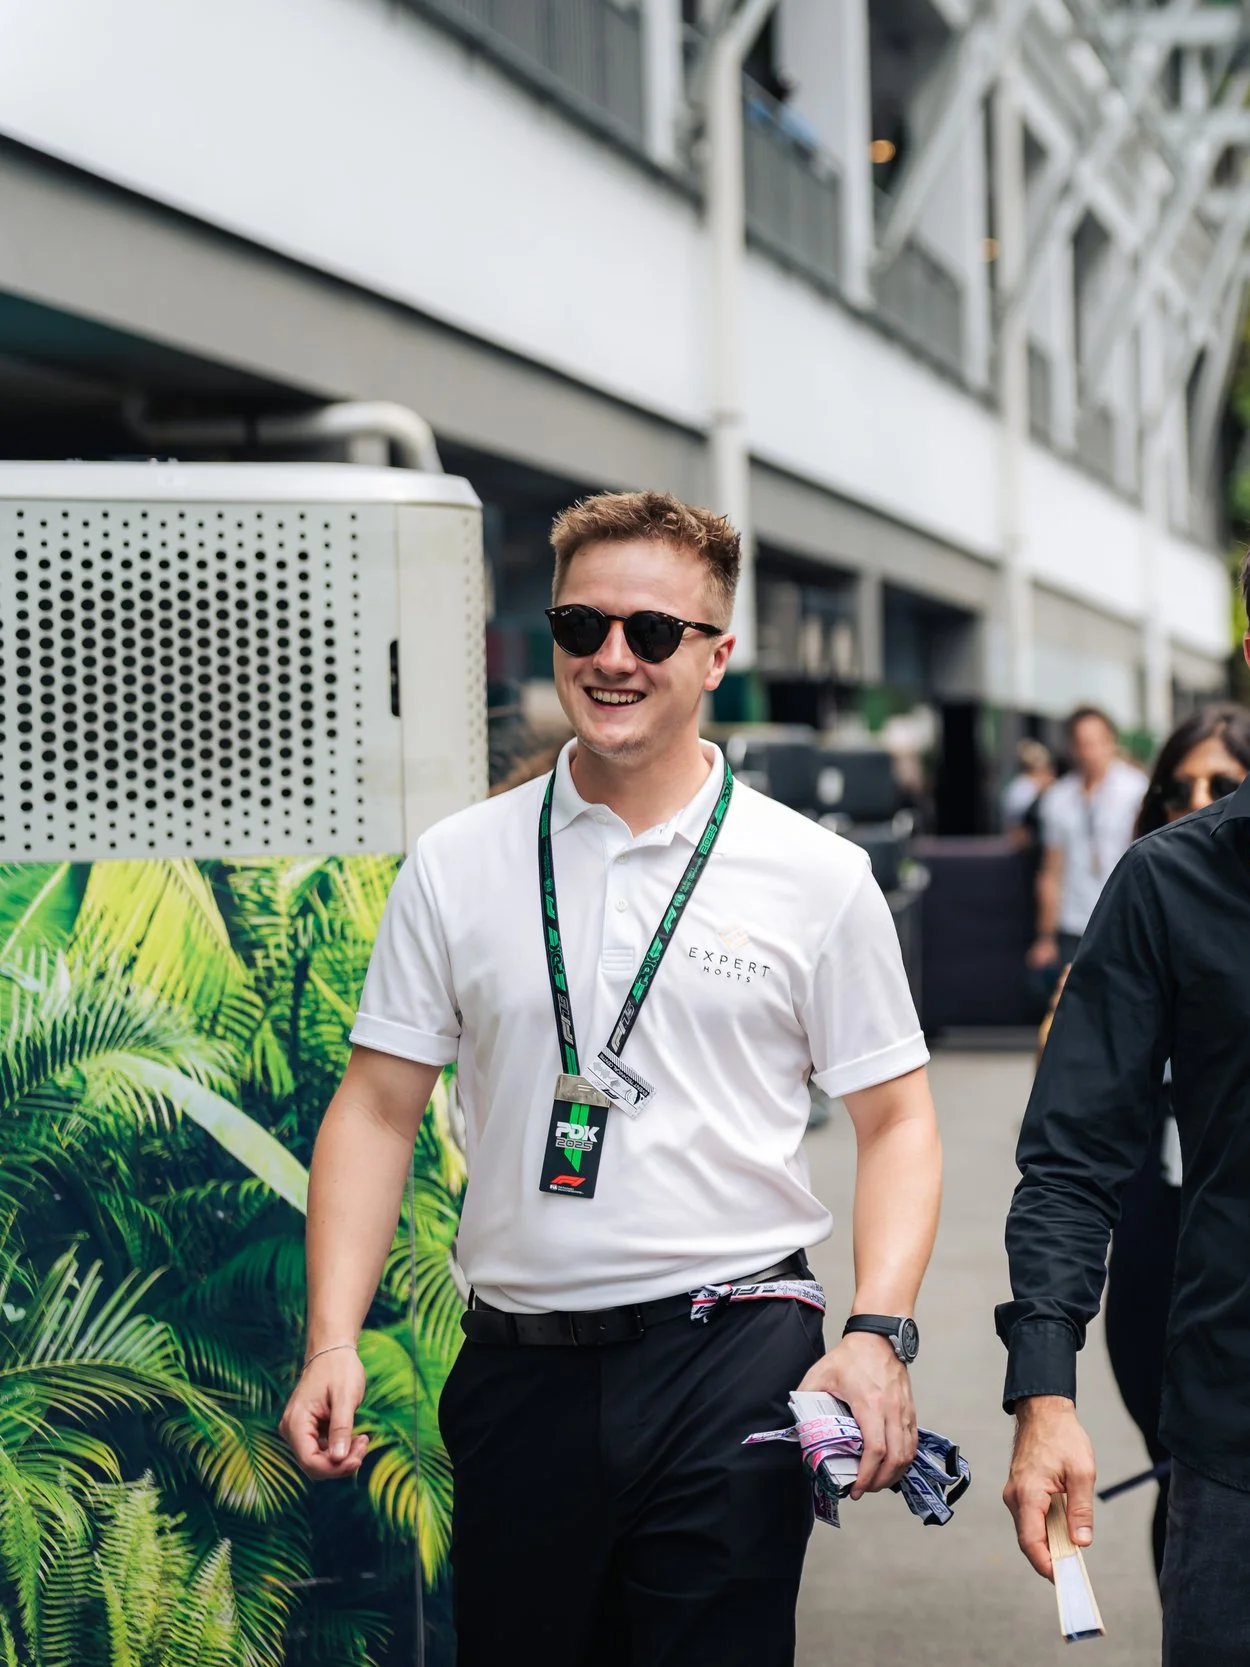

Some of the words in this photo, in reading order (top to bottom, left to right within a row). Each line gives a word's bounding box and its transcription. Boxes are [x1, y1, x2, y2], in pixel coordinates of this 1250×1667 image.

[688, 946, 772, 978] EXPERT
[703, 966, 752, 983] HOSTS
[555, 1121, 600, 1142] PDK
[555, 1137, 593, 1152] 2025
[551, 1174, 586, 1187] F1
